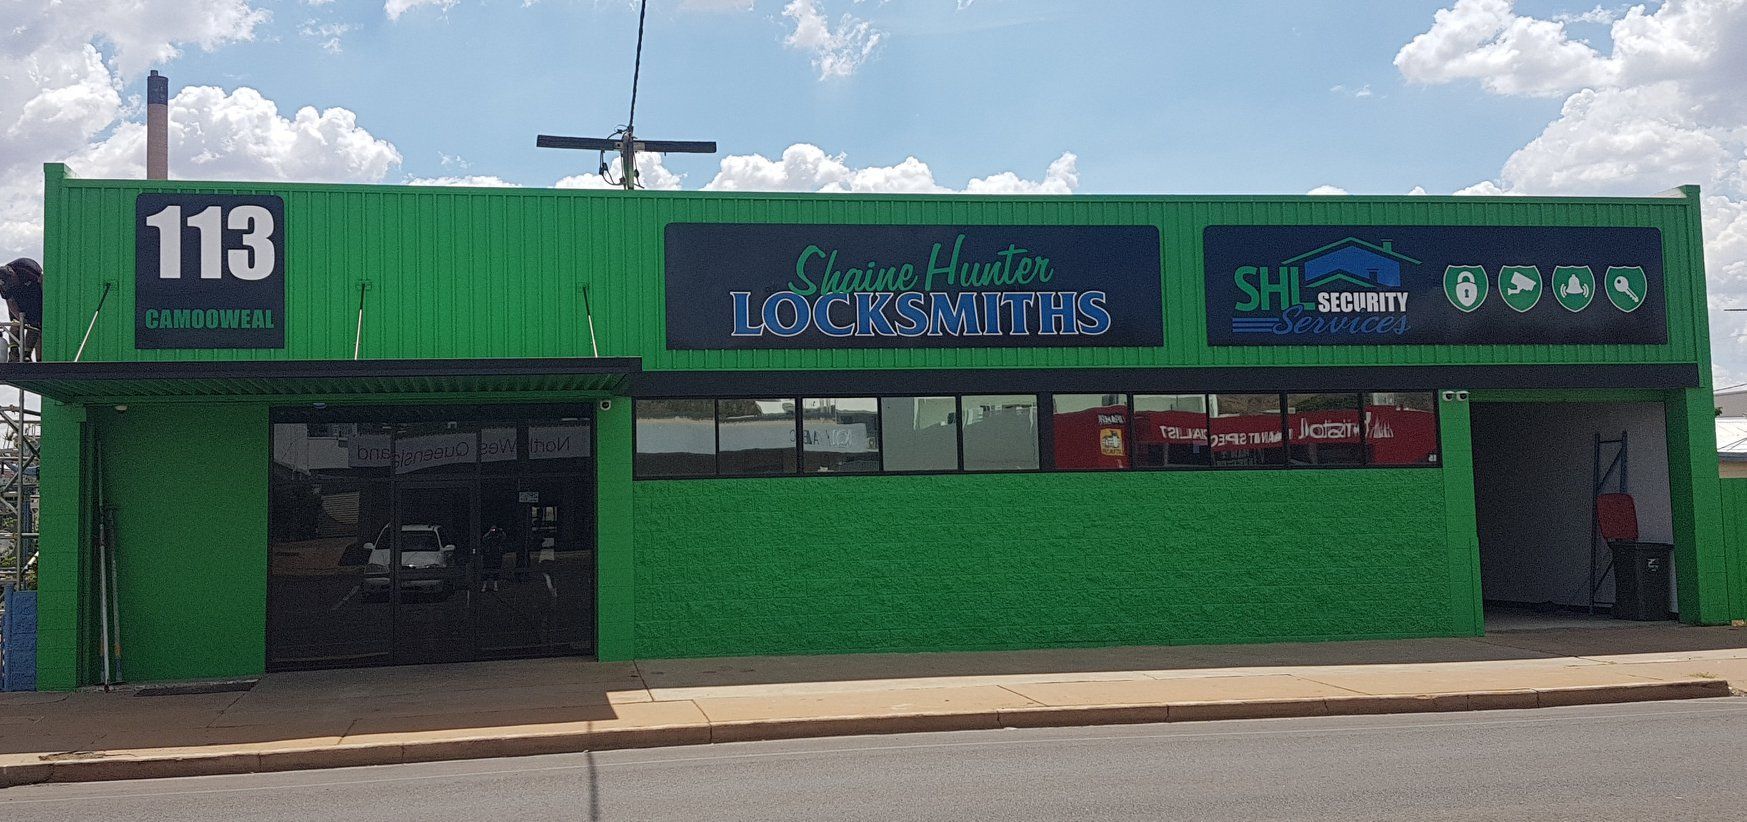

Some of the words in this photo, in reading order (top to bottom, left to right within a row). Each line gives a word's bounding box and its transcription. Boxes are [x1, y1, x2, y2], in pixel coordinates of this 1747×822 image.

[146, 205, 276, 281] 113
[788, 244, 917, 297] Shaine
[925, 234, 1054, 292] Hunter
[1234, 265, 1316, 312] SHL
[1317, 292, 1409, 313] SECURITY
[145, 308, 274, 330] CAMOOWEAL
[730, 289, 1112, 337] LOCKSMITHS
[1272, 304, 1411, 335] Services
